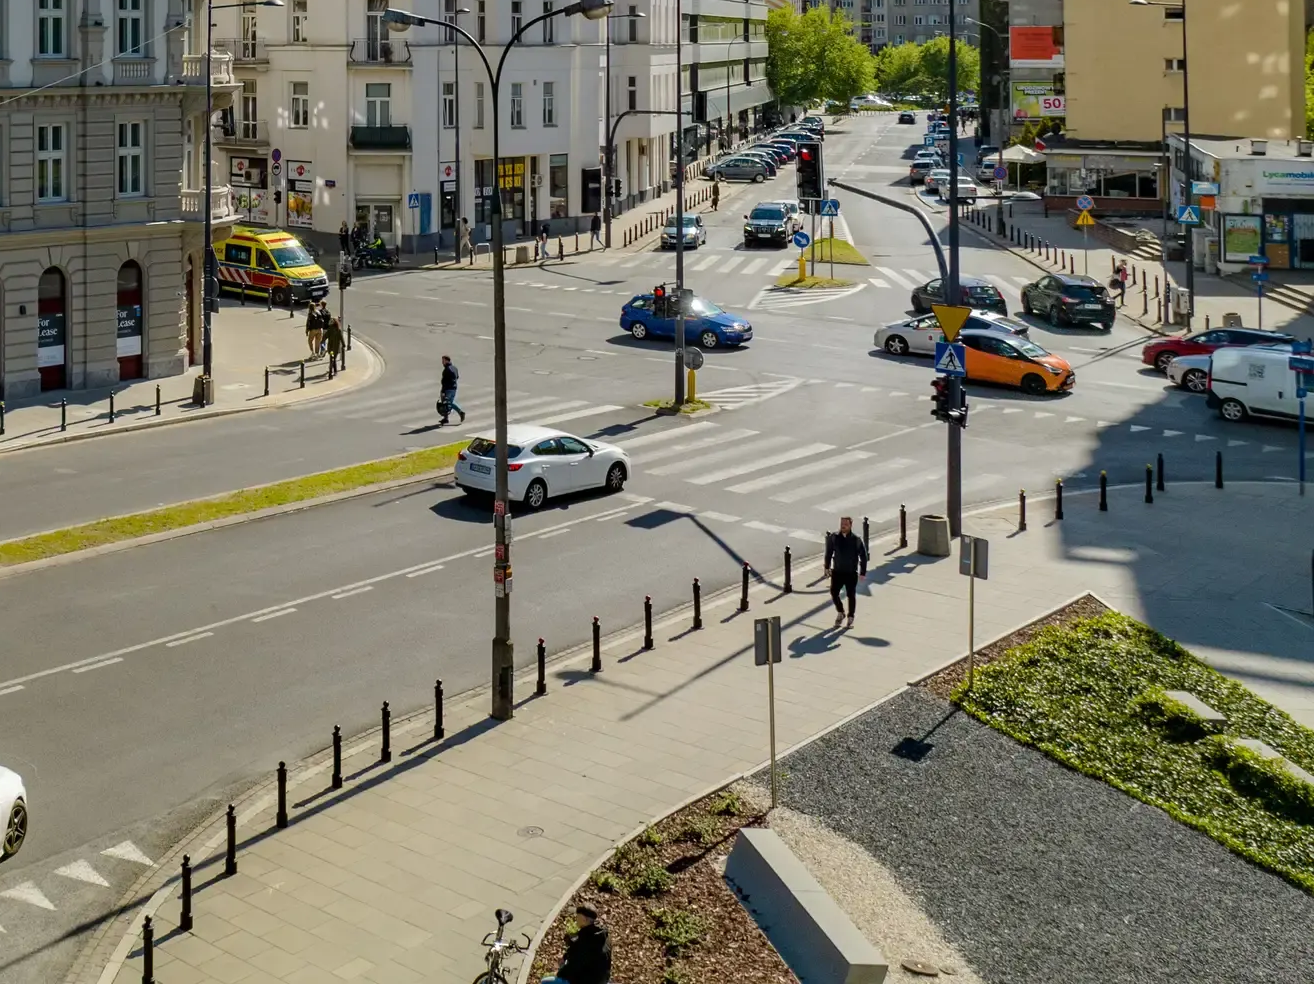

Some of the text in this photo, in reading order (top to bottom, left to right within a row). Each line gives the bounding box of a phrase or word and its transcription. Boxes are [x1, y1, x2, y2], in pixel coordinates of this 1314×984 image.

[1043, 98, 1061, 109] 50
[1262, 170, 1314, 180] Lycamobil
[37, 318, 50, 327] For
[118, 319, 136, 328] ease
